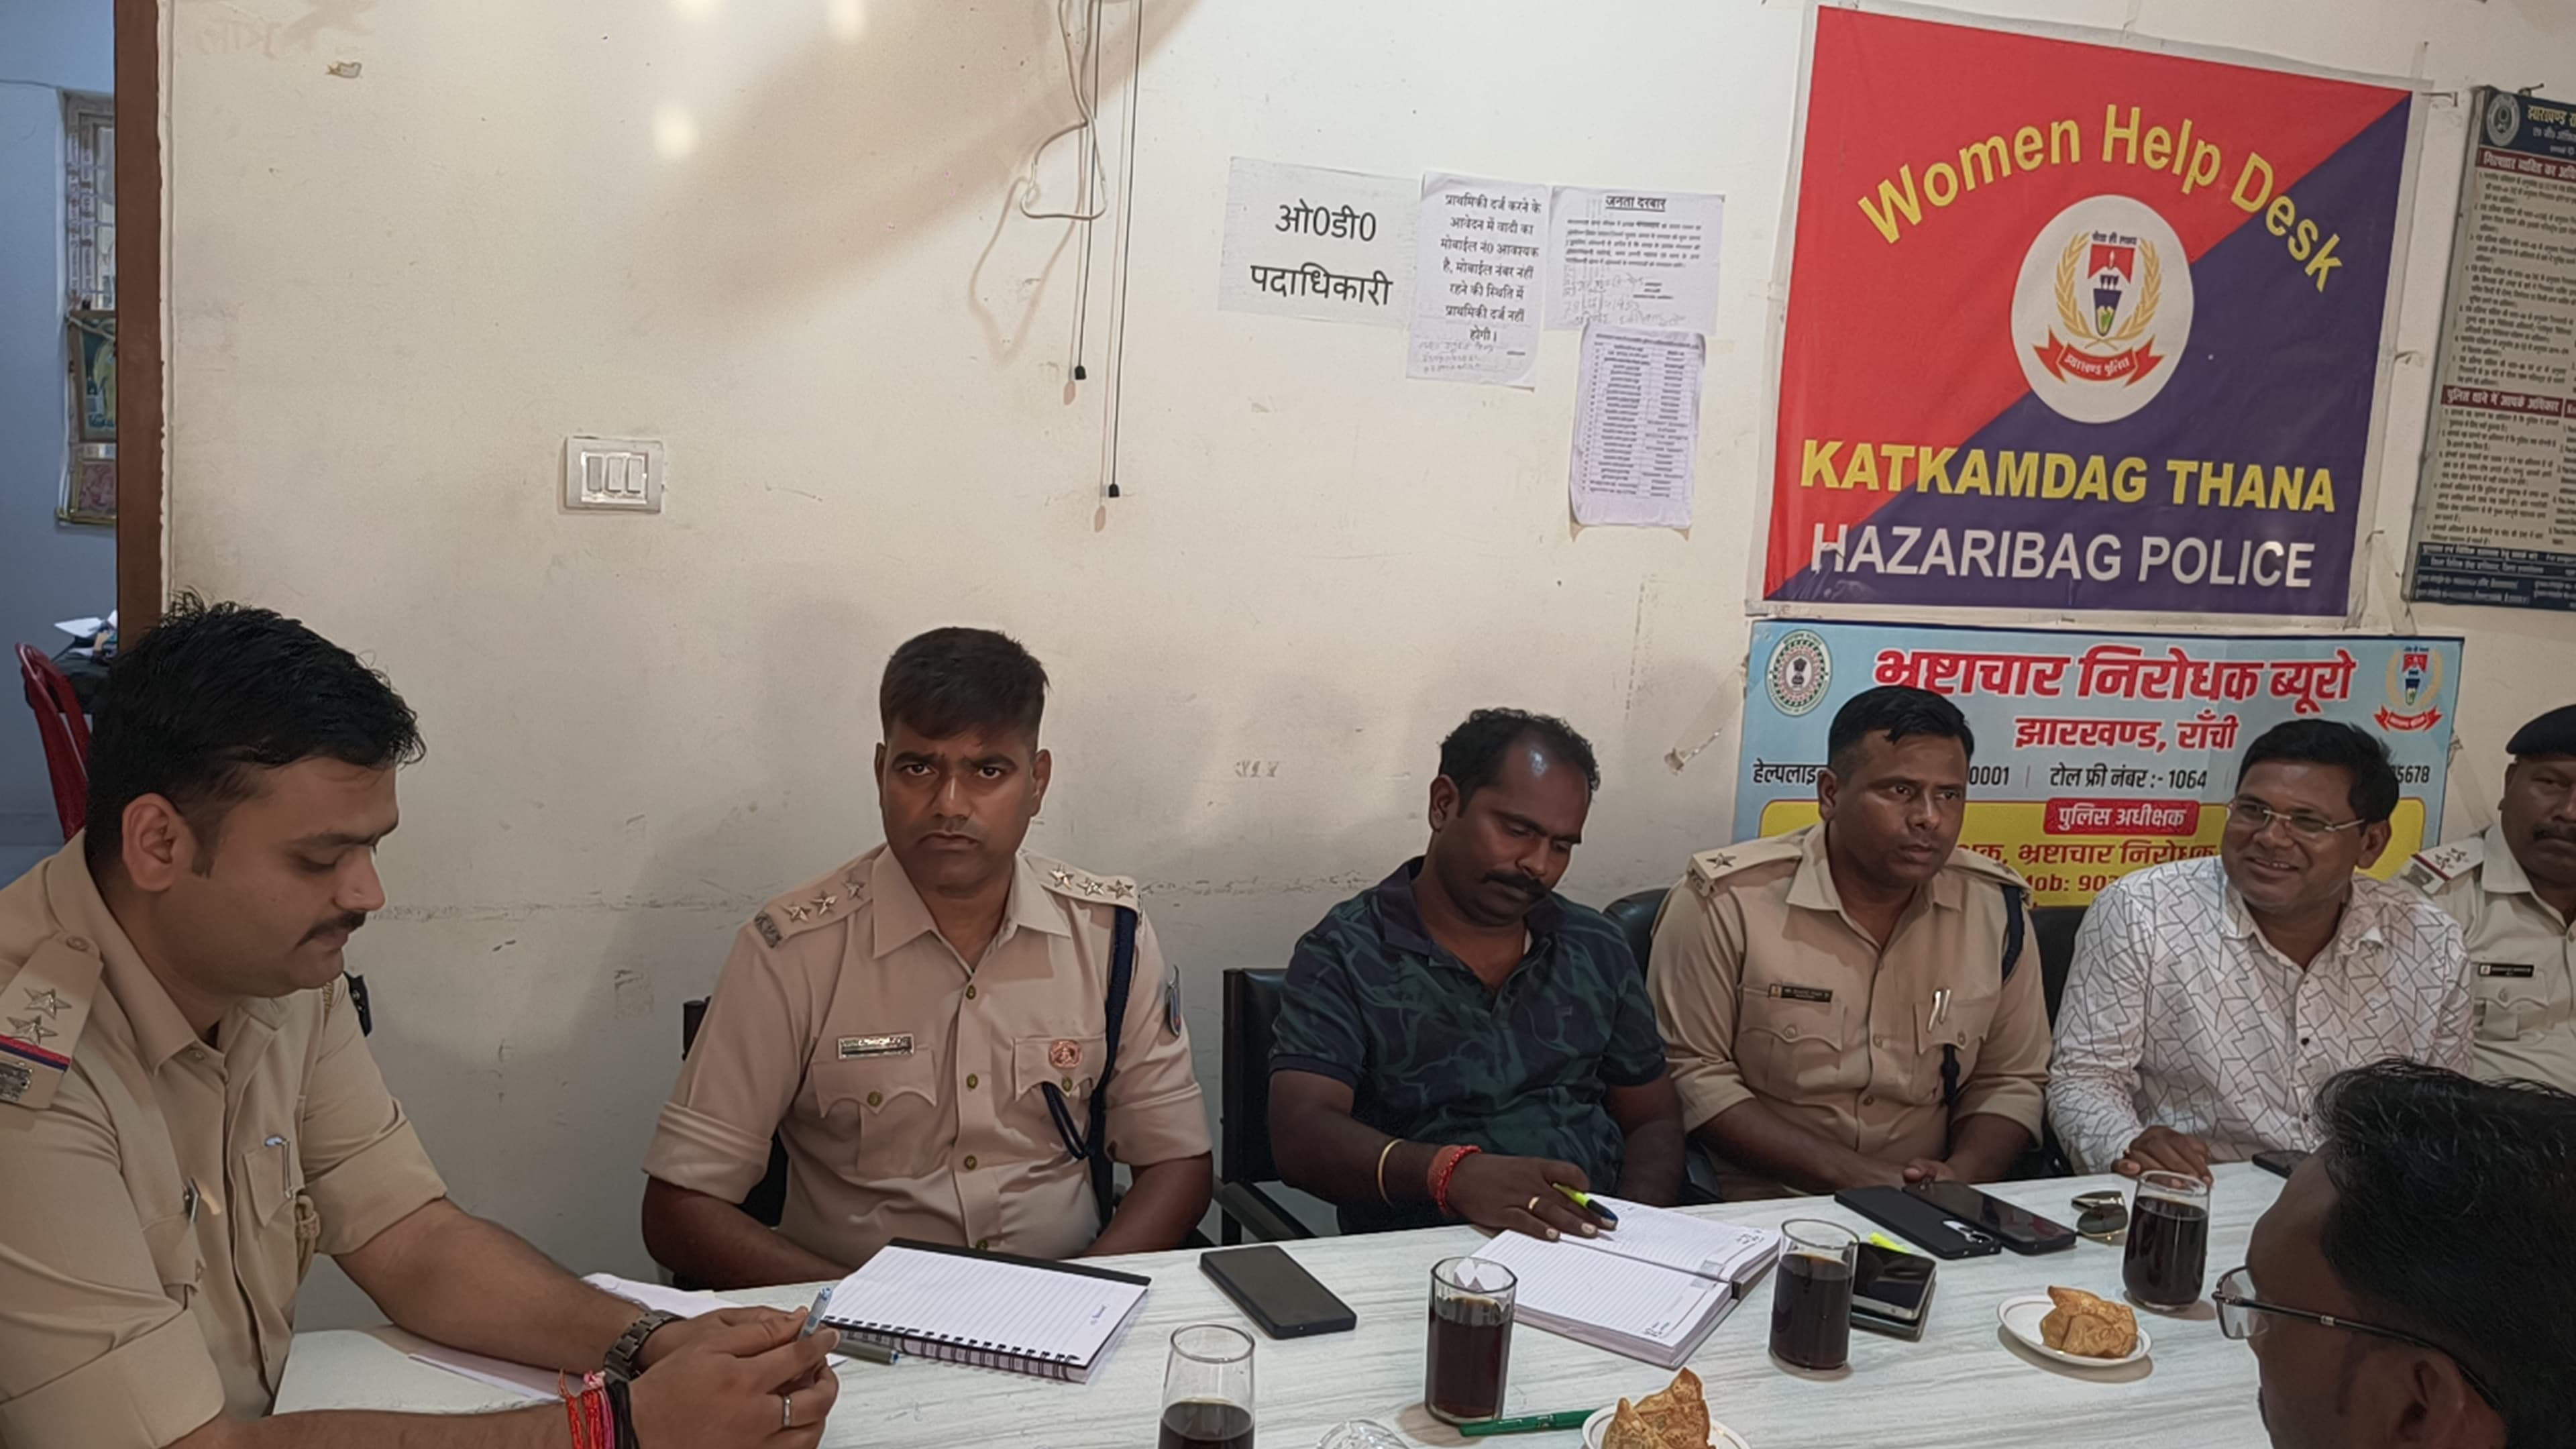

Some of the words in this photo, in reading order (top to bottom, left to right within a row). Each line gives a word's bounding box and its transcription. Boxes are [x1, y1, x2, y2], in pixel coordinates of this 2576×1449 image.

[1446, 192, 1487, 209] प्राथमिकी
[1491, 196, 1506, 211] दर्ज
[1508, 197, 1529, 213] करने
[1532, 199, 1542, 213] के
[1606, 196, 1635, 209] जनता
[1637, 198, 1667, 211] दरबार
[1858, 119, 2080, 244] Women
[2102, 103, 2221, 195] Help
[2231, 152, 2343, 292] Desk
[1450, 214, 1484, 230] आवेदन
[1497, 219, 1518, 233] वादी
[1520, 223, 1534, 235] का
[1441, 235, 1477, 252] मोबाईल
[1456, 258, 1493, 276] मोबाईल
[1495, 264, 1513, 277] नंबर
[1250, 262, 1393, 305] पदाधिकारी
[1450, 280, 1468, 296] रहने
[1470, 282, 1483, 297] की
[1487, 282, 1513, 299] स्थिति
[1516, 285, 1524, 300] में
[1446, 303, 1487, 319] प्राथमिकी
[1490, 305, 1505, 320] दर्ज
[1800, 439, 2147, 502] KATKAMDAG
[2166, 459, 2335, 513] THANA
[1810, 523, 2121, 582] HAZARIBAG
[2139, 535, 2315, 588] POLICE
[1875, 650, 2071, 696] भ्रष्टाचार
[2078, 646, 2265, 701] निरोधक
[2269, 649, 2357, 714] ब्यूरो
[2015, 716, 2165, 753] झारखण्ड,
[2176, 709, 2239, 750] राँची
[1753, 757, 1827, 786] हेल्पलाइ
[1969, 766, 2009, 786] 0001
[2050, 763, 2082, 787] टोल
[2086, 763, 2107, 788] फ्री
[2111, 765, 2148, 788] नंबर
[2169, 769, 2208, 789] 1064
[2394, 765, 2430, 784] 5678
[2058, 802, 2112, 831] पुलिस
[2116, 804, 2187, 828] अधीक्षक
[2018, 843, 2114, 865] भ्रष्टाचार
